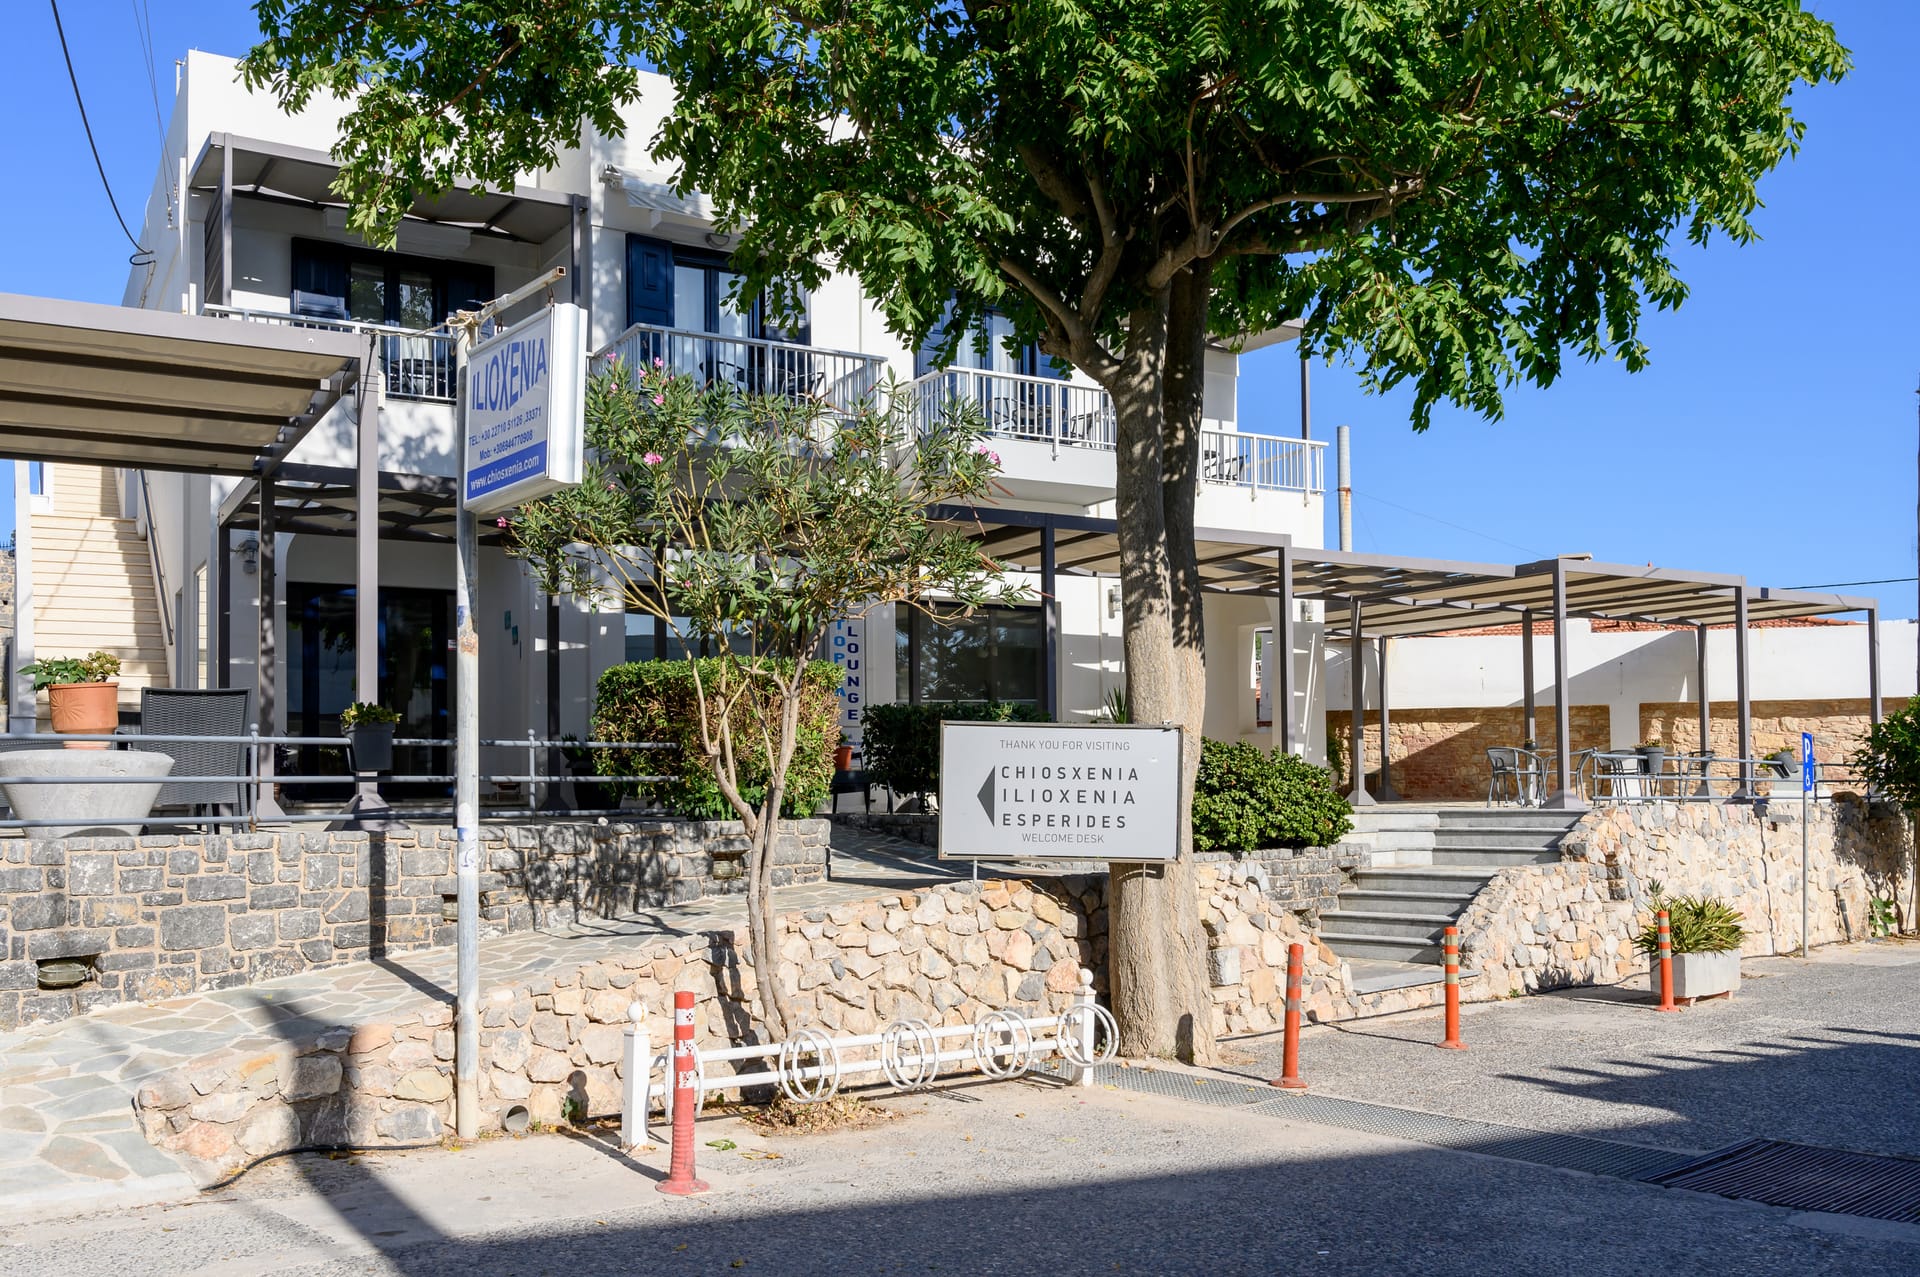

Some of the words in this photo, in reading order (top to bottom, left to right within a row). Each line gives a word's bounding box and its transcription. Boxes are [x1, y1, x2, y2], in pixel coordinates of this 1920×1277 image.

[472, 338, 547, 411] ILIOXENIA
[469, 433, 480, 446] TEL:
[481, 428, 490, 441] +30
[491, 421, 506, 438] 22710
[507, 415, 523, 431] 51126
[480, 446, 492, 461] Mob:
[470, 455, 539, 491] www.chiosxenia.com
[847, 626, 860, 720] LOUNGE
[1000, 740, 1036, 750] THANK
[1038, 741, 1059, 751] YOU
[1062, 741, 1083, 751] FOR
[1085, 741, 1130, 751] VISITING
[1804, 737, 1811, 763] P
[1001, 766, 1138, 781] CHIOSXENIA
[1003, 788, 1135, 804] ILIOXENIA
[1002, 813, 1126, 829] ESPERIDES
[1022, 833, 1074, 843] WELCOME
[1076, 834, 1105, 844] DESK
